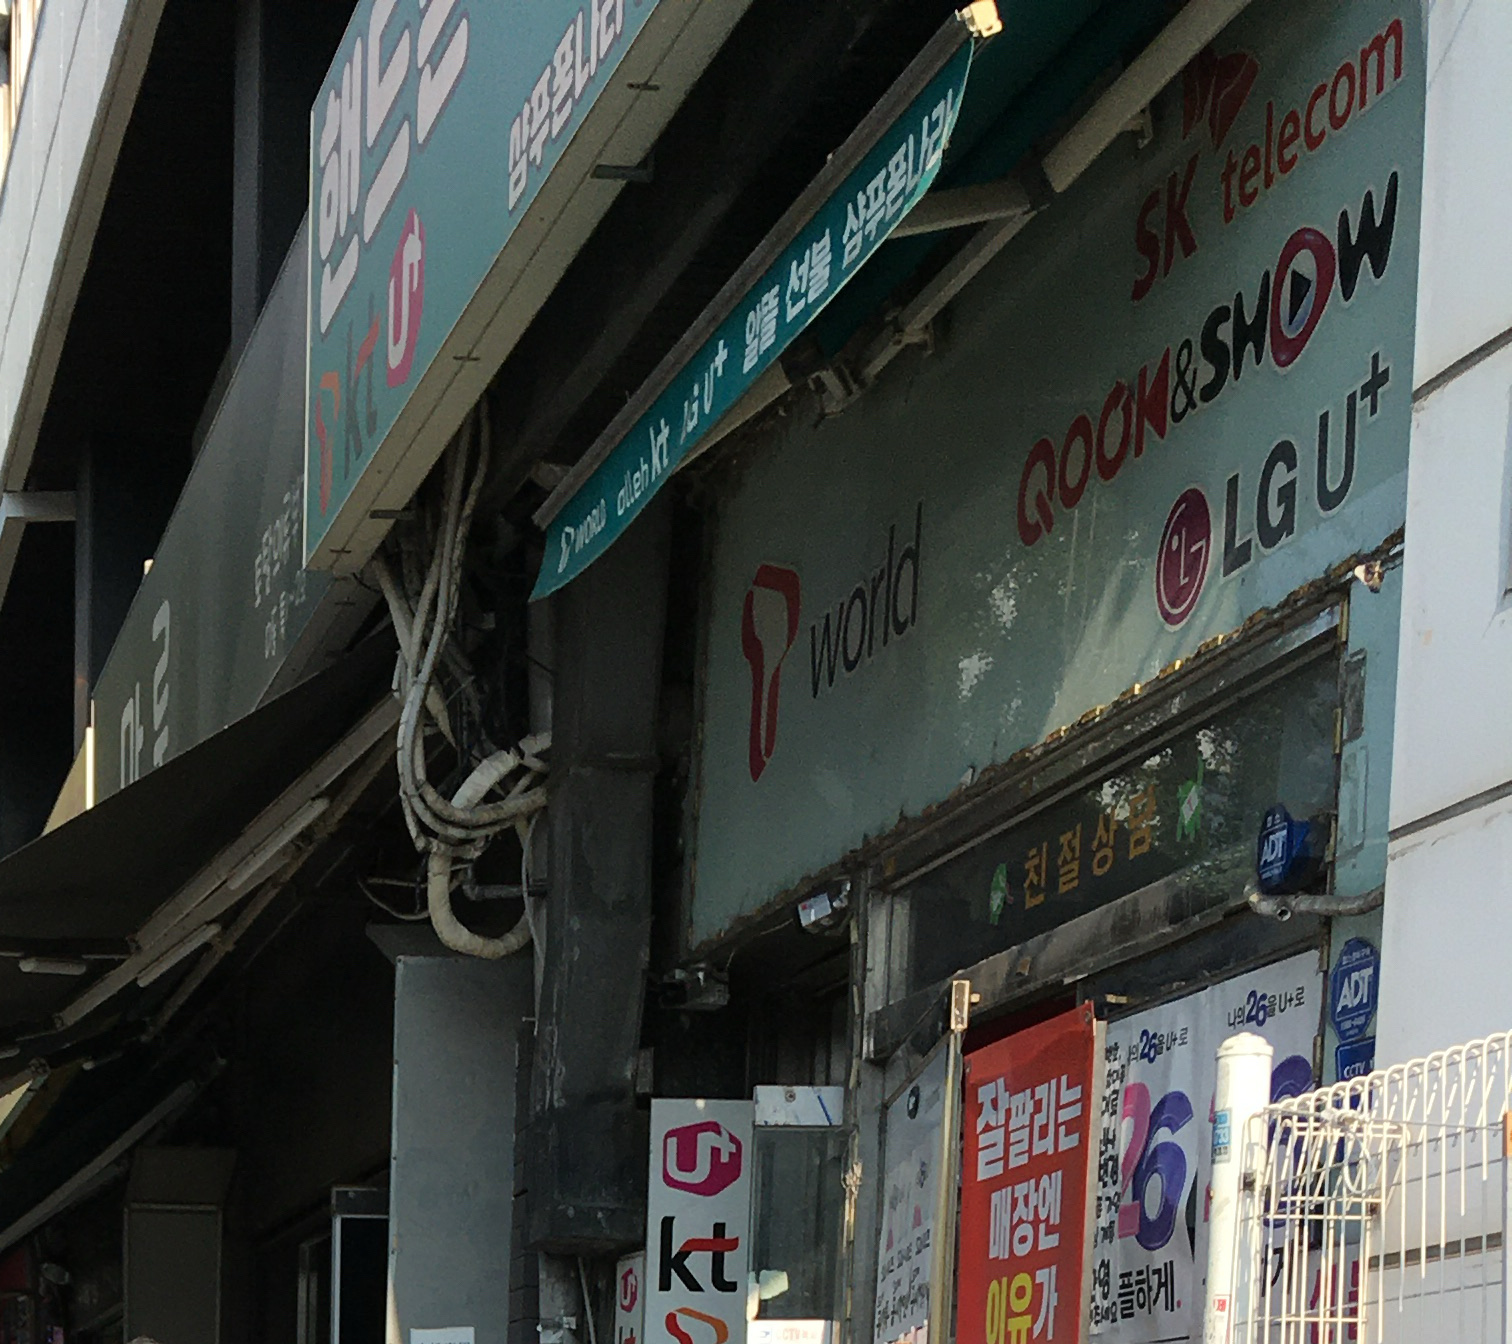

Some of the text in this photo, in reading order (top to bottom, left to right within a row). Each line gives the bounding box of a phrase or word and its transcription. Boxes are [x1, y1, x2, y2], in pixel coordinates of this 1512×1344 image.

[1131, 17, 1404, 302] SK telecom
[786, 227, 832, 325] 선불
[1221, 350, 1391, 580] LG U+
[809, 499, 924, 700] world
[1022, 783, 1158, 912] 친절상담
[1260, 829, 1288, 866] ADT
[1227, 985, 1306, 1030] 나의 26을 U+로
[1337, 965, 1375, 1016] ADT
[1166, 1026, 1189, 1052] U+로
[1344, 1061, 1367, 1080] CCTV
[667, 1125, 737, 1185] U+
[976, 1073, 1085, 1184] 잘팔리는
[658, 1215, 740, 1293] kt
[988, 1169, 1063, 1263] 매장에
[1118, 1258, 1184, 1320] 플하게.
